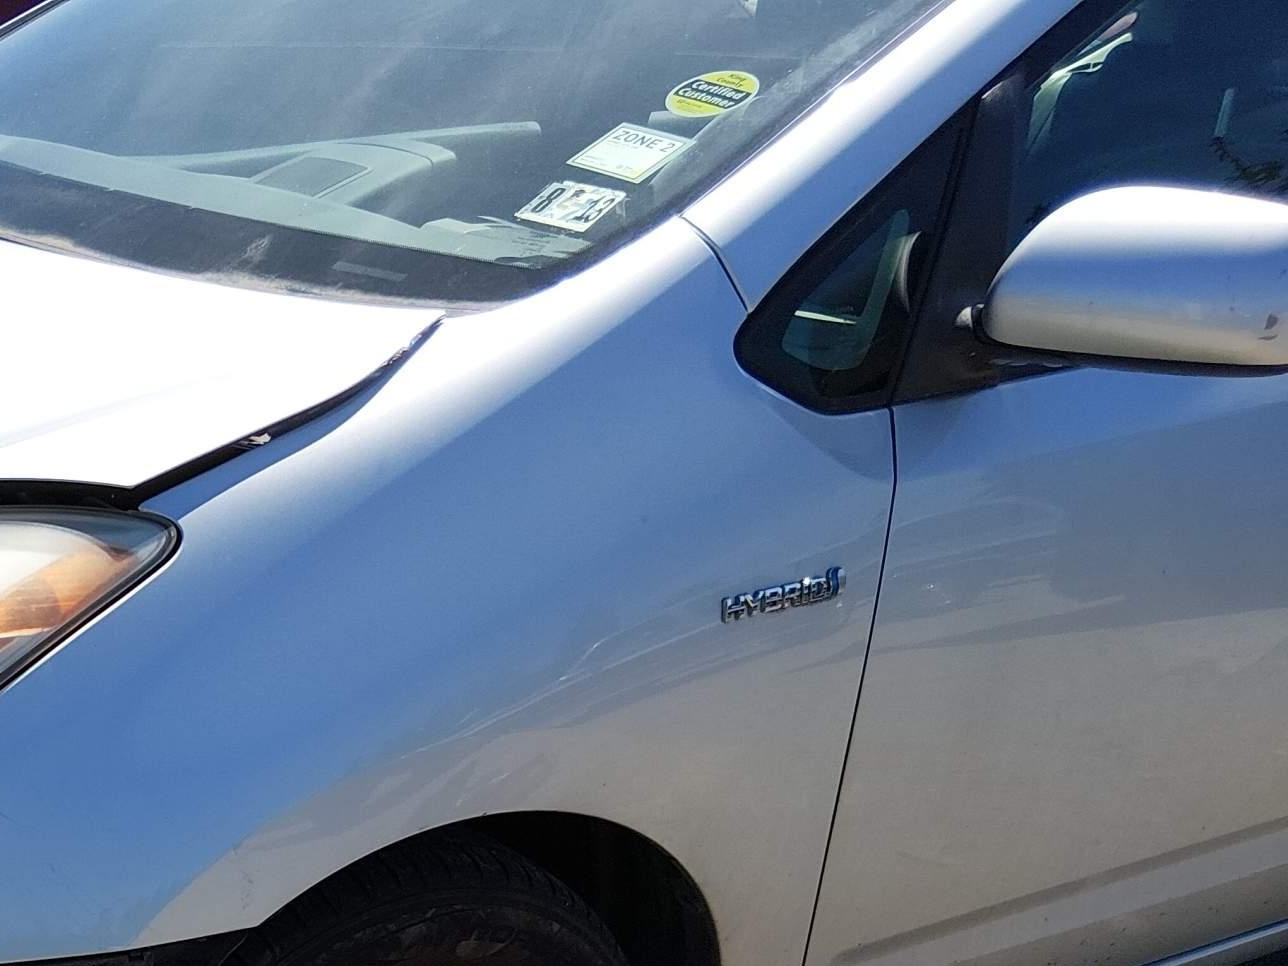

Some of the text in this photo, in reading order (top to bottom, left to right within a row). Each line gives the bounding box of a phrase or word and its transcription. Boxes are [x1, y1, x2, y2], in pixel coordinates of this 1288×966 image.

[678, 88, 735, 108] Customer
[692, 81, 746, 100] Certified
[613, 130, 660, 149] ZONE
[659, 143, 675, 152] 2
[531, 187, 566, 213] 8
